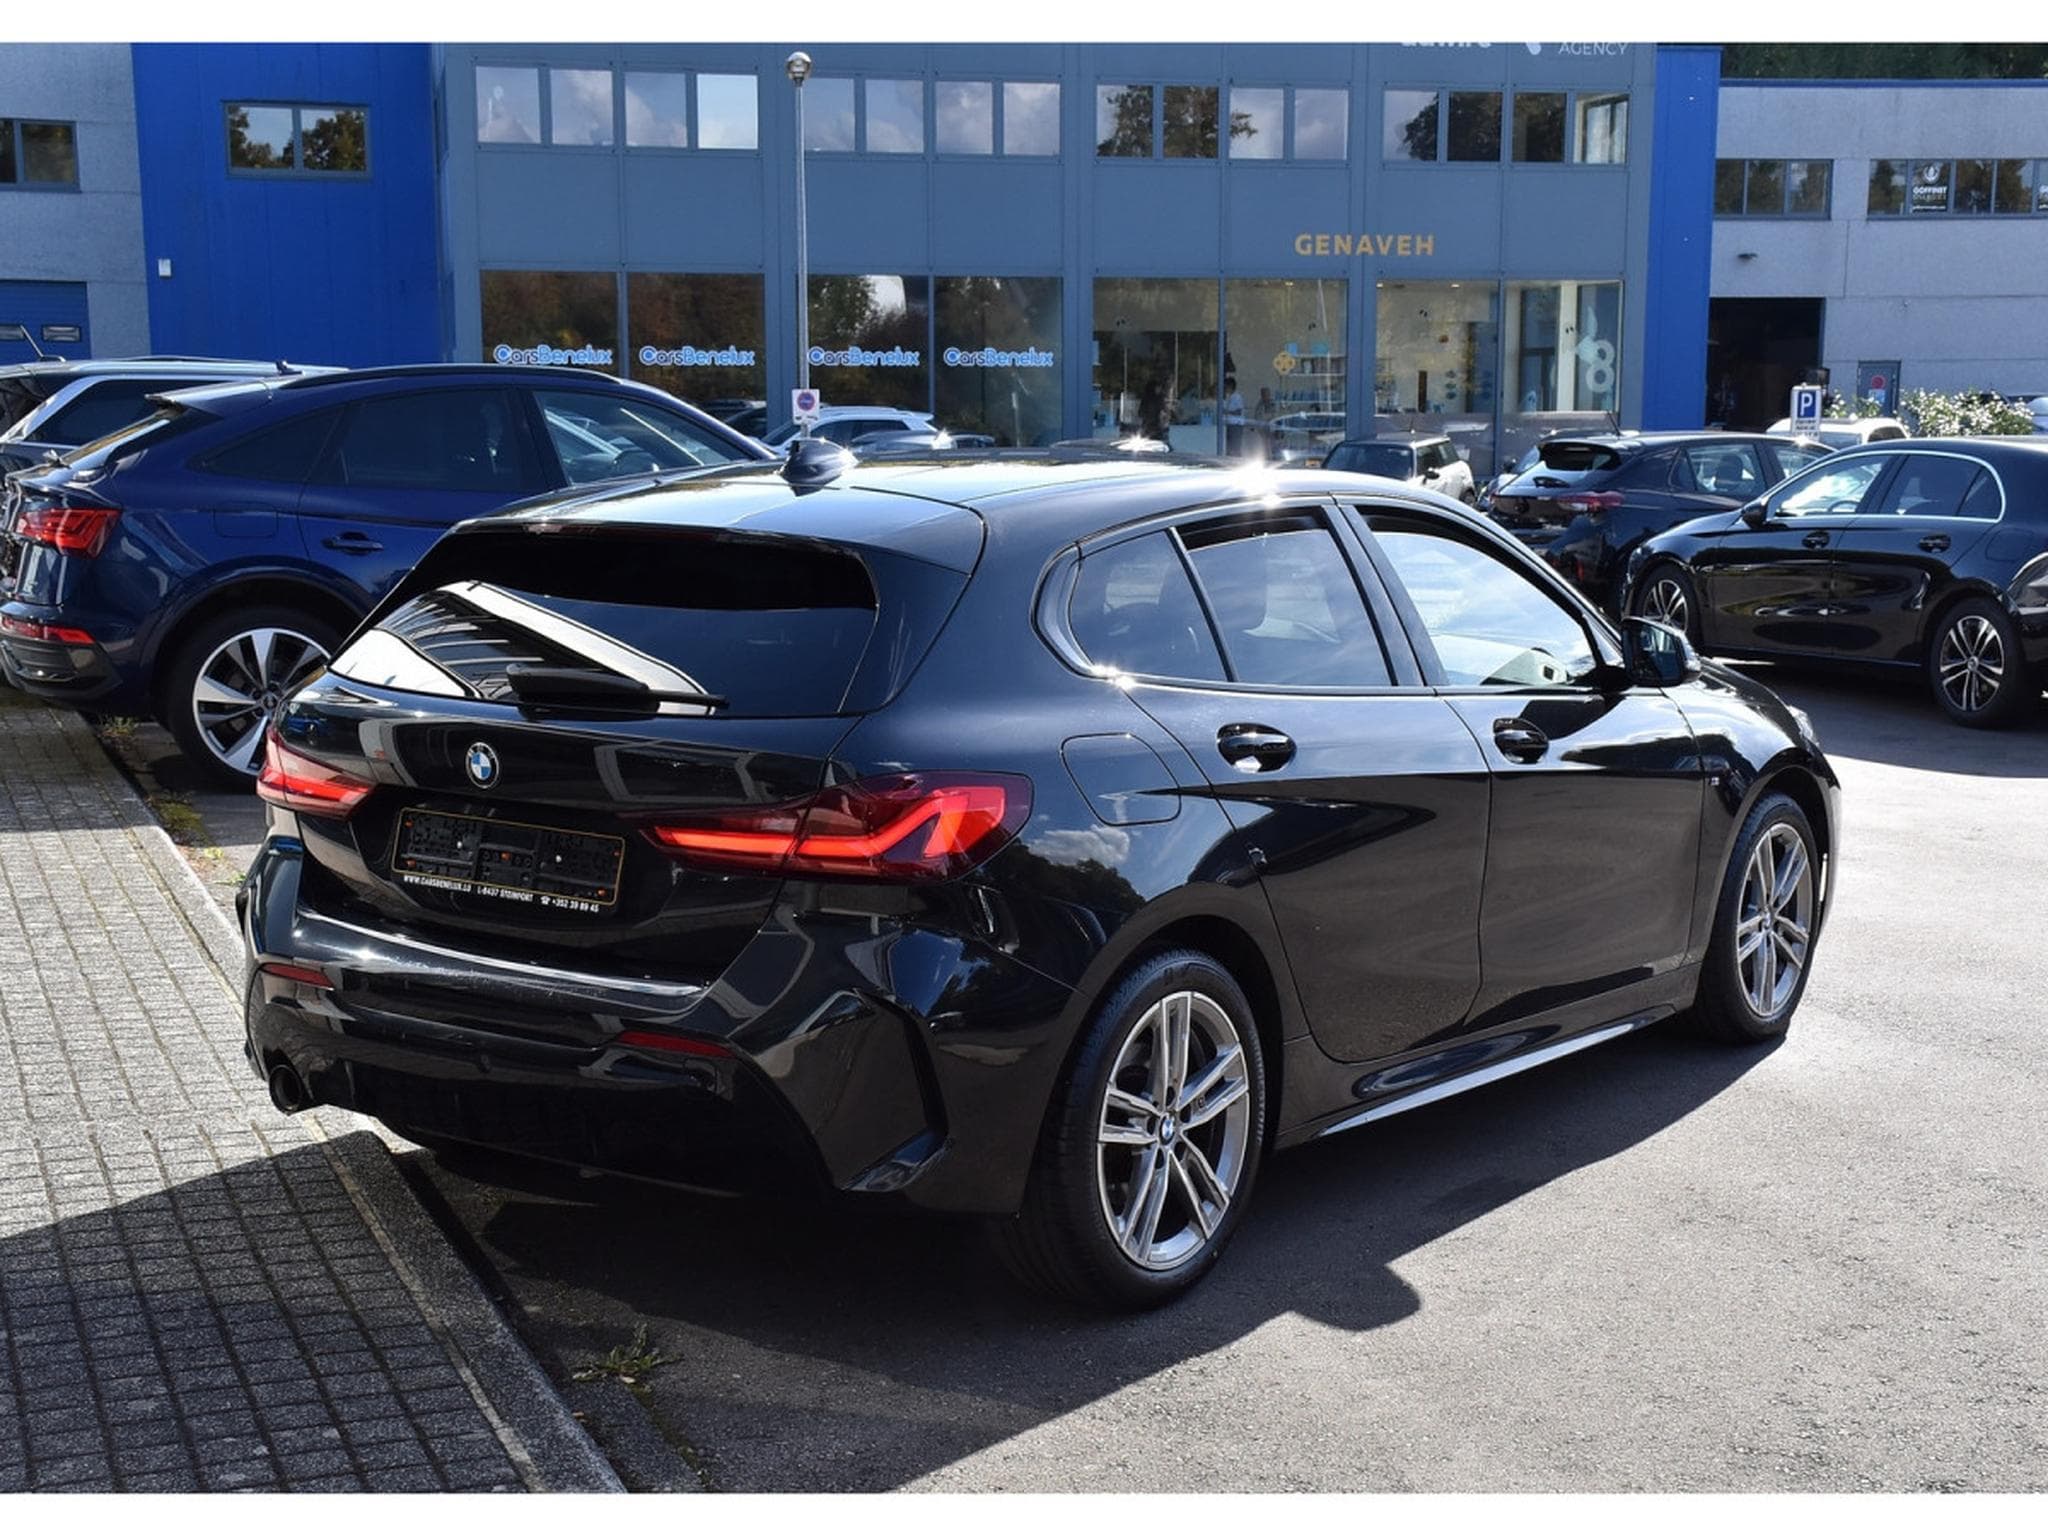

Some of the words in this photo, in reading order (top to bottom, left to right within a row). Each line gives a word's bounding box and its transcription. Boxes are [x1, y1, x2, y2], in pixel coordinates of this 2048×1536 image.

[1558, 42, 1629, 56] AGENCY
[1294, 234, 1436, 257] GENAVEH
[493, 344, 613, 366] CarsBenelux
[638, 345, 756, 367] CarsBenelux
[807, 345, 920, 367] CarsBenelux
[943, 346, 1054, 368] CarsBenelux
[1800, 392, 1813, 416] P
